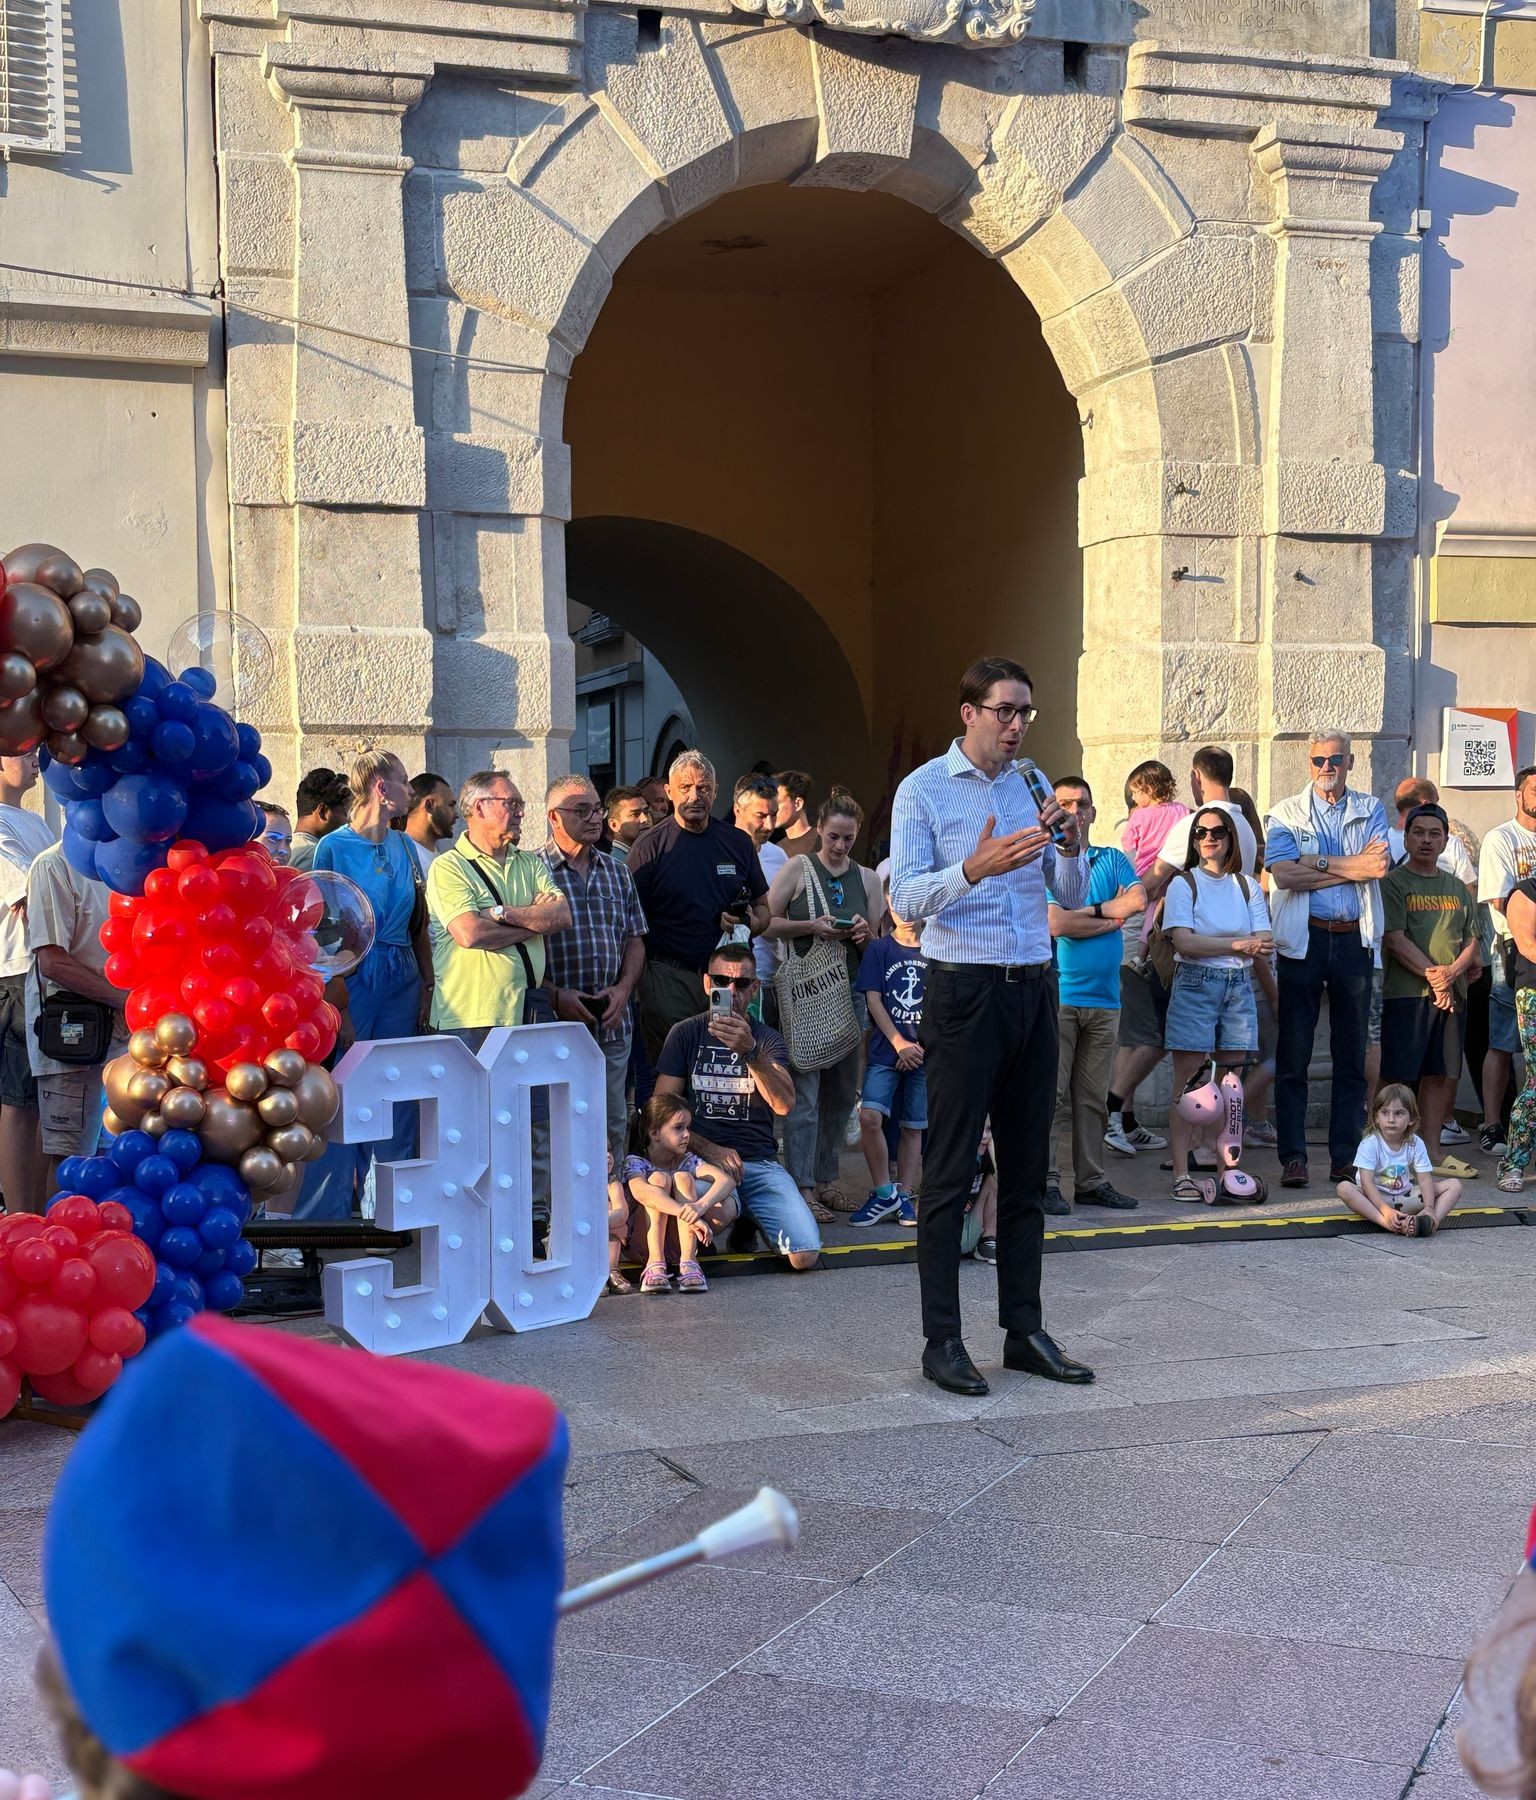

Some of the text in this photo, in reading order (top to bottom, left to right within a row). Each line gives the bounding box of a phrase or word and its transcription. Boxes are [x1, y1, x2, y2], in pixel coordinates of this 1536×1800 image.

[1184, 9, 1229, 24] ANNO
[791, 964, 847, 1003] SUNSHINE
[730, 1052, 739, 1065] 9
[727, 1105, 736, 1116] 6
[324, 1021, 609, 1356] 30
